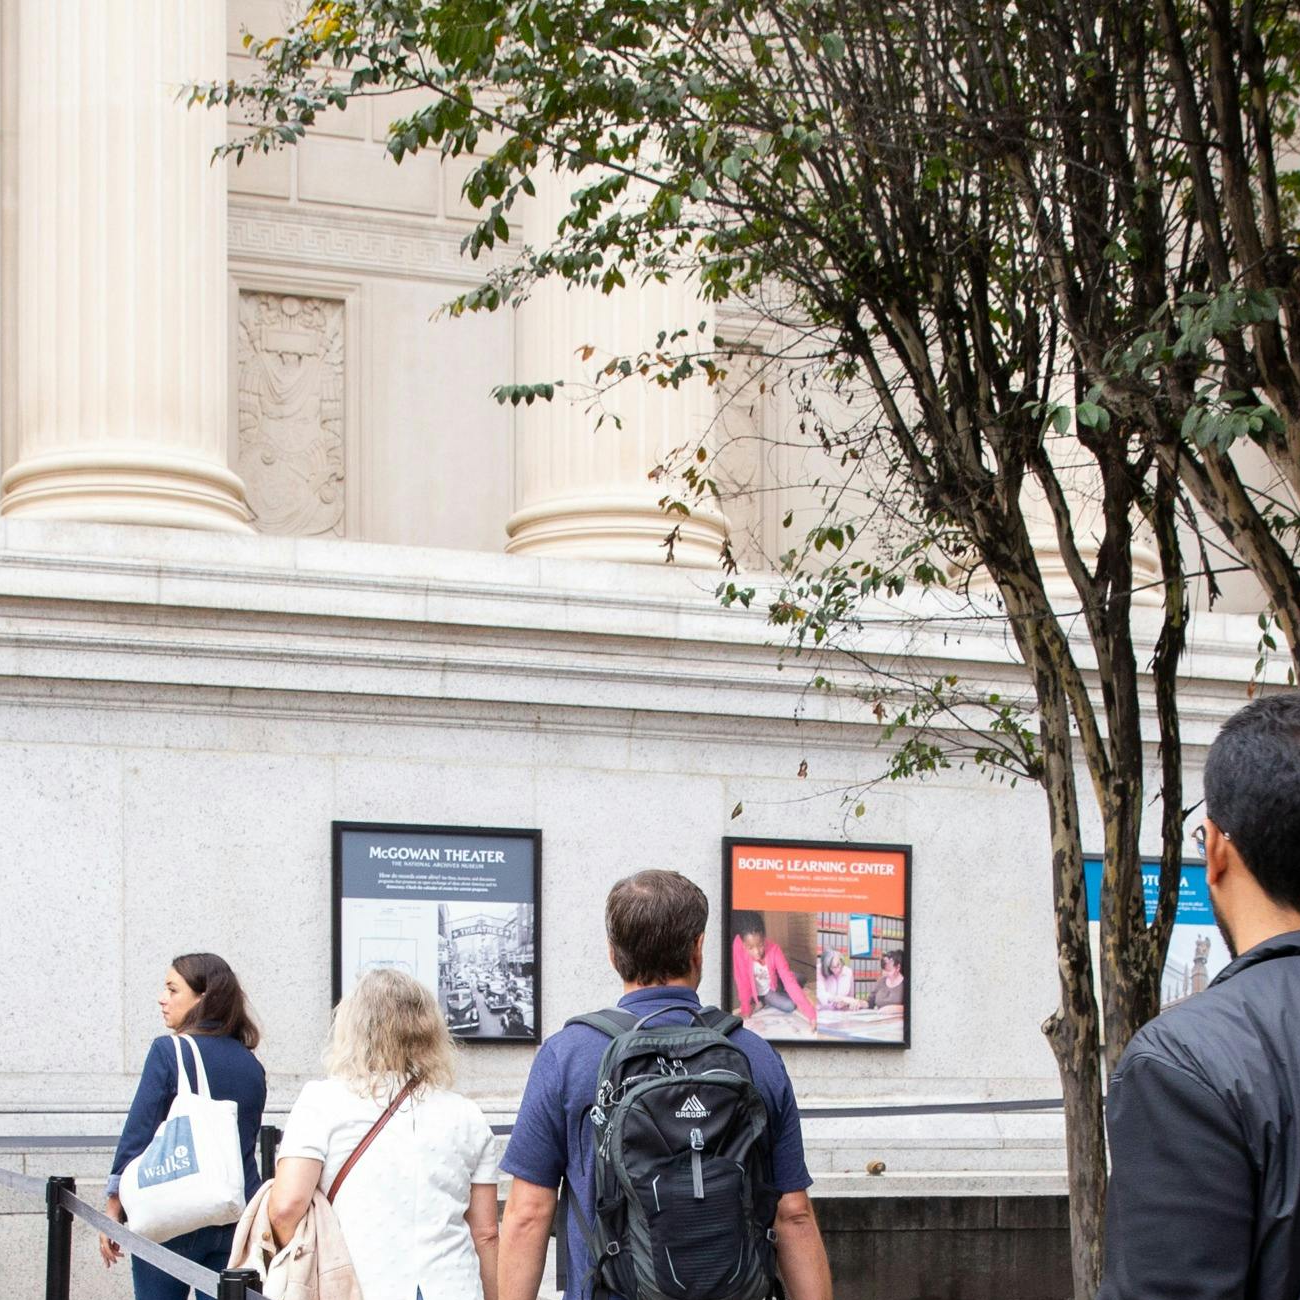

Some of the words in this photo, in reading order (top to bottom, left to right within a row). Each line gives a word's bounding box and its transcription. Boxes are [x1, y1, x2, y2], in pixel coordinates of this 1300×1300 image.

[369, 846, 440, 860] McGOWAN
[444, 848, 506, 863] THEATER
[738, 858, 784, 871] BOEING
[787, 860, 847, 873] LEARNING
[850, 862, 895, 875] CENTER
[144, 1154, 190, 1180] walks
